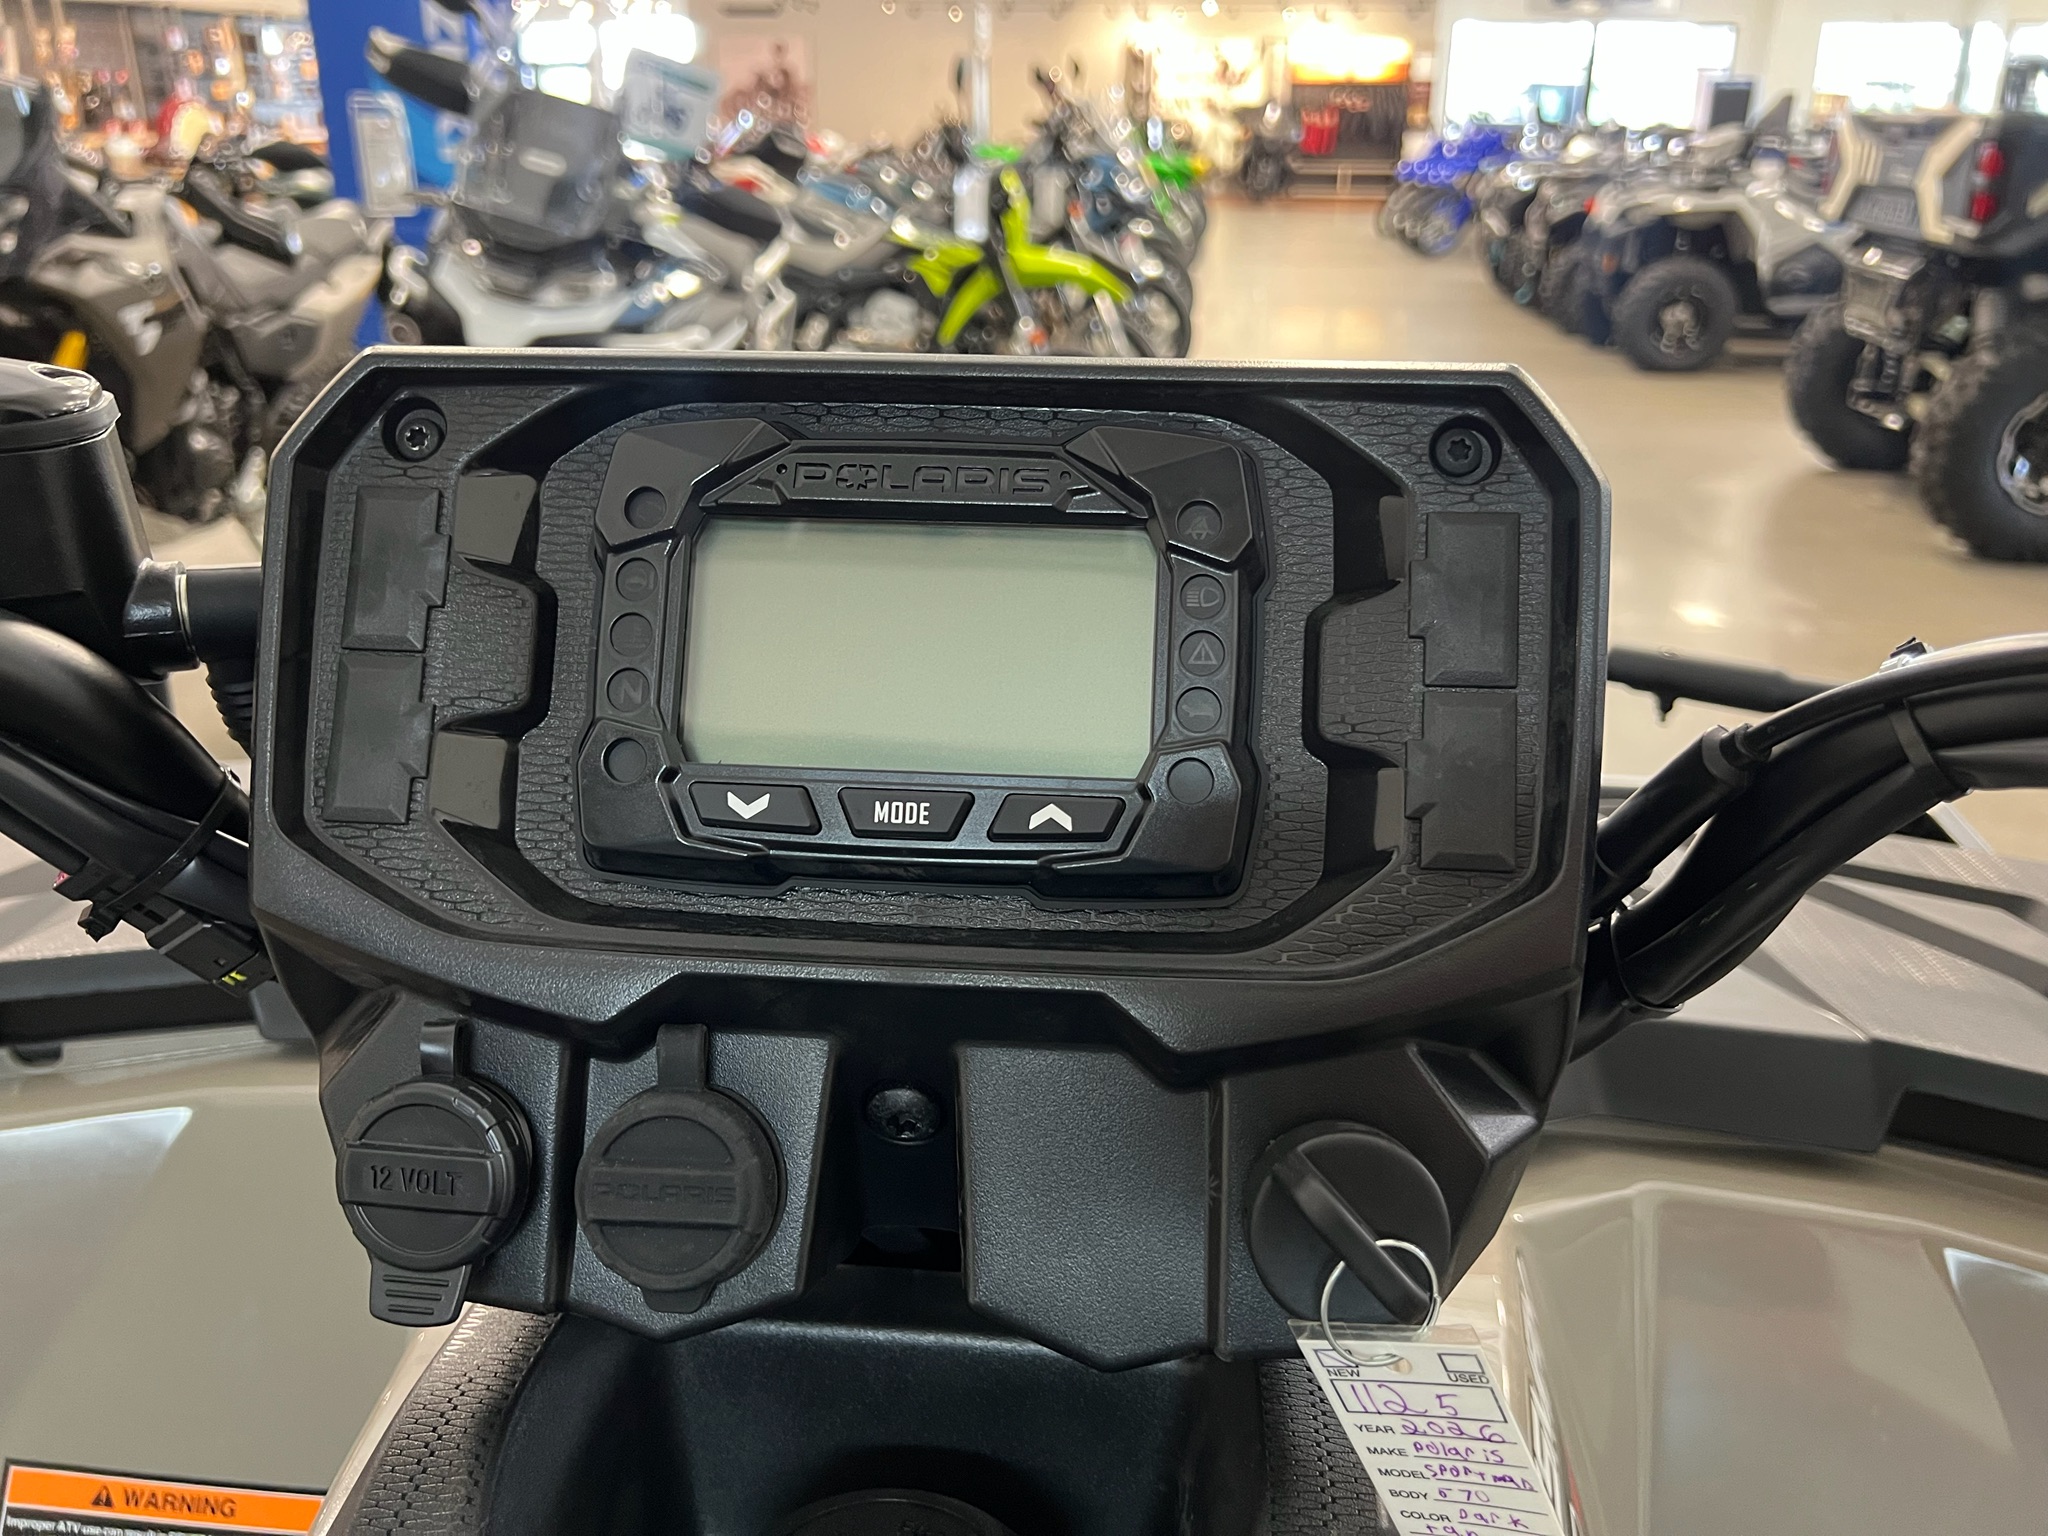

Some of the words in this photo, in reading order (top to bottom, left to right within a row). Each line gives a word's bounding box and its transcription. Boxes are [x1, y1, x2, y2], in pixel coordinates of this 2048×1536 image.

[793, 463, 1051, 495] POLARIS
[873, 800, 931, 825] MODE
[371, 1165, 393, 1191] 12
[400, 1167, 462, 1196] VOLT
[593, 1182, 738, 1203] POLARIS
[1326, 1368, 1360, 1378] NEW
[1446, 1372, 1490, 1385] USED
[1353, 1423, 1396, 1435] YEAR
[1401, 1418, 1507, 1444] 2026
[1366, 1446, 1409, 1457] MAKE
[1377, 1467, 1430, 1480] MODEL
[124, 1487, 237, 1518] WARNING
[1388, 1489, 1428, 1500] BODY
[1438, 1487, 1491, 1502] 570
[6, 1515, 57, 1532] Improper
[1400, 1509, 1452, 1523] COLOR
